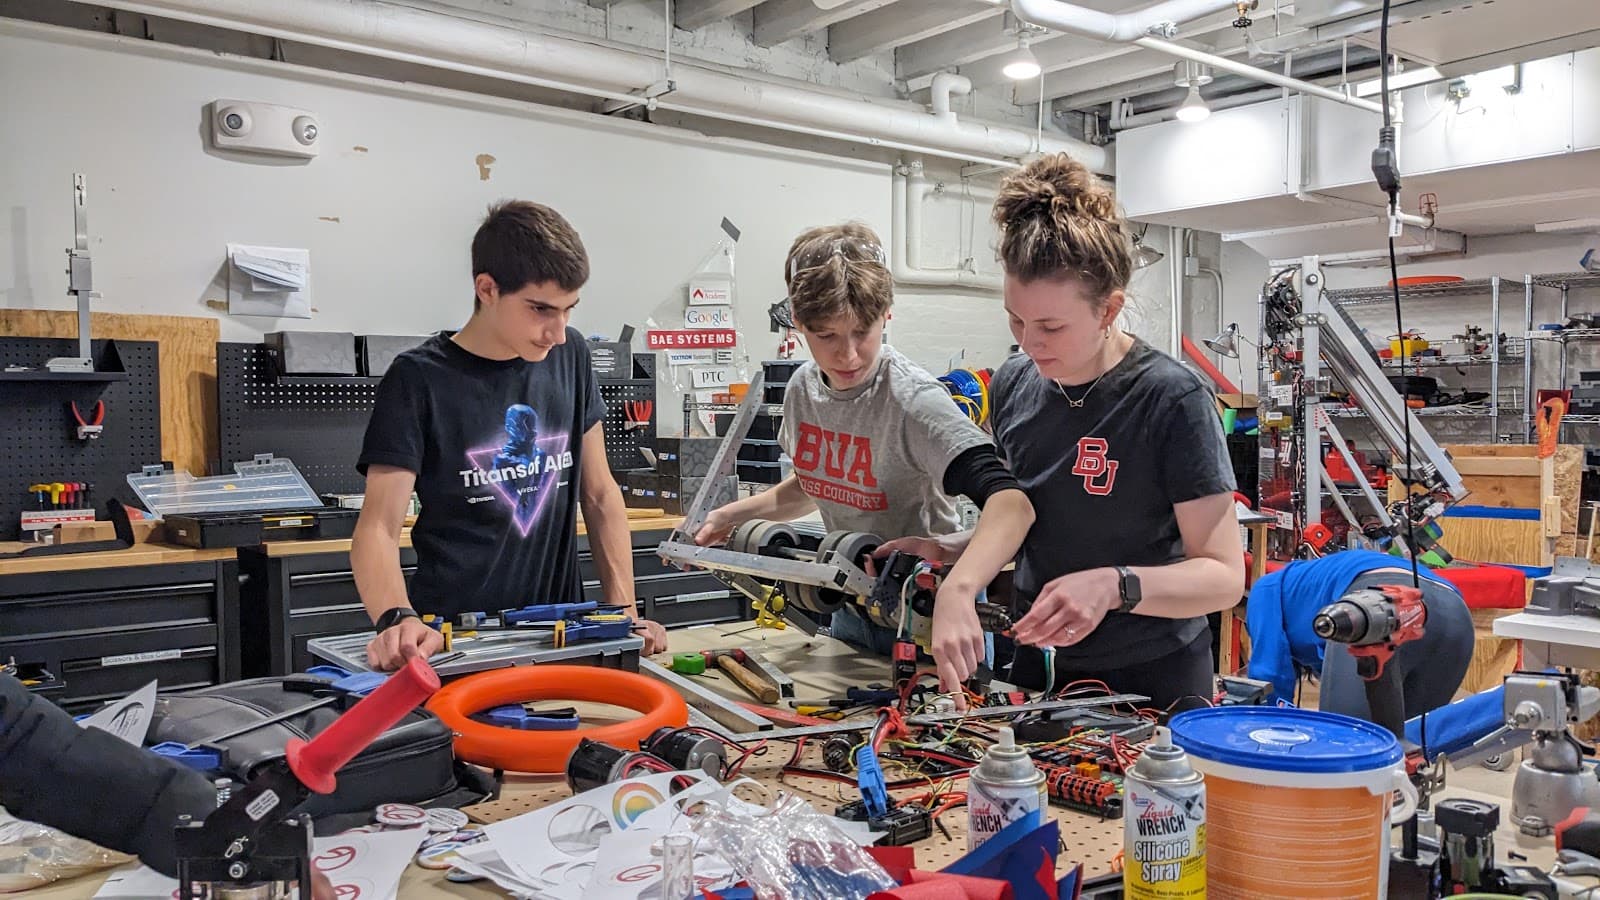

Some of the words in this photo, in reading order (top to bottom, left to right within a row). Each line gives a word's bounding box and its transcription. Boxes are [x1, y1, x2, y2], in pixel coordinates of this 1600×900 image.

[687, 309, 728, 327] Google
[651, 335, 673, 344] BAE
[677, 333, 733, 344] SYSTEMS
[702, 371, 725, 383] PTC
[793, 421, 877, 488] BUA
[1071, 436, 1120, 496] BU
[460, 464, 528, 488] Titans
[527, 456, 541, 475] of
[823, 485, 882, 509] COUNTRY
[1140, 801, 1175, 824] Liquid
[1136, 814, 1186, 836] WRENCH
[1134, 839, 1190, 863] Silicone
[1141, 861, 1183, 884] Spray
